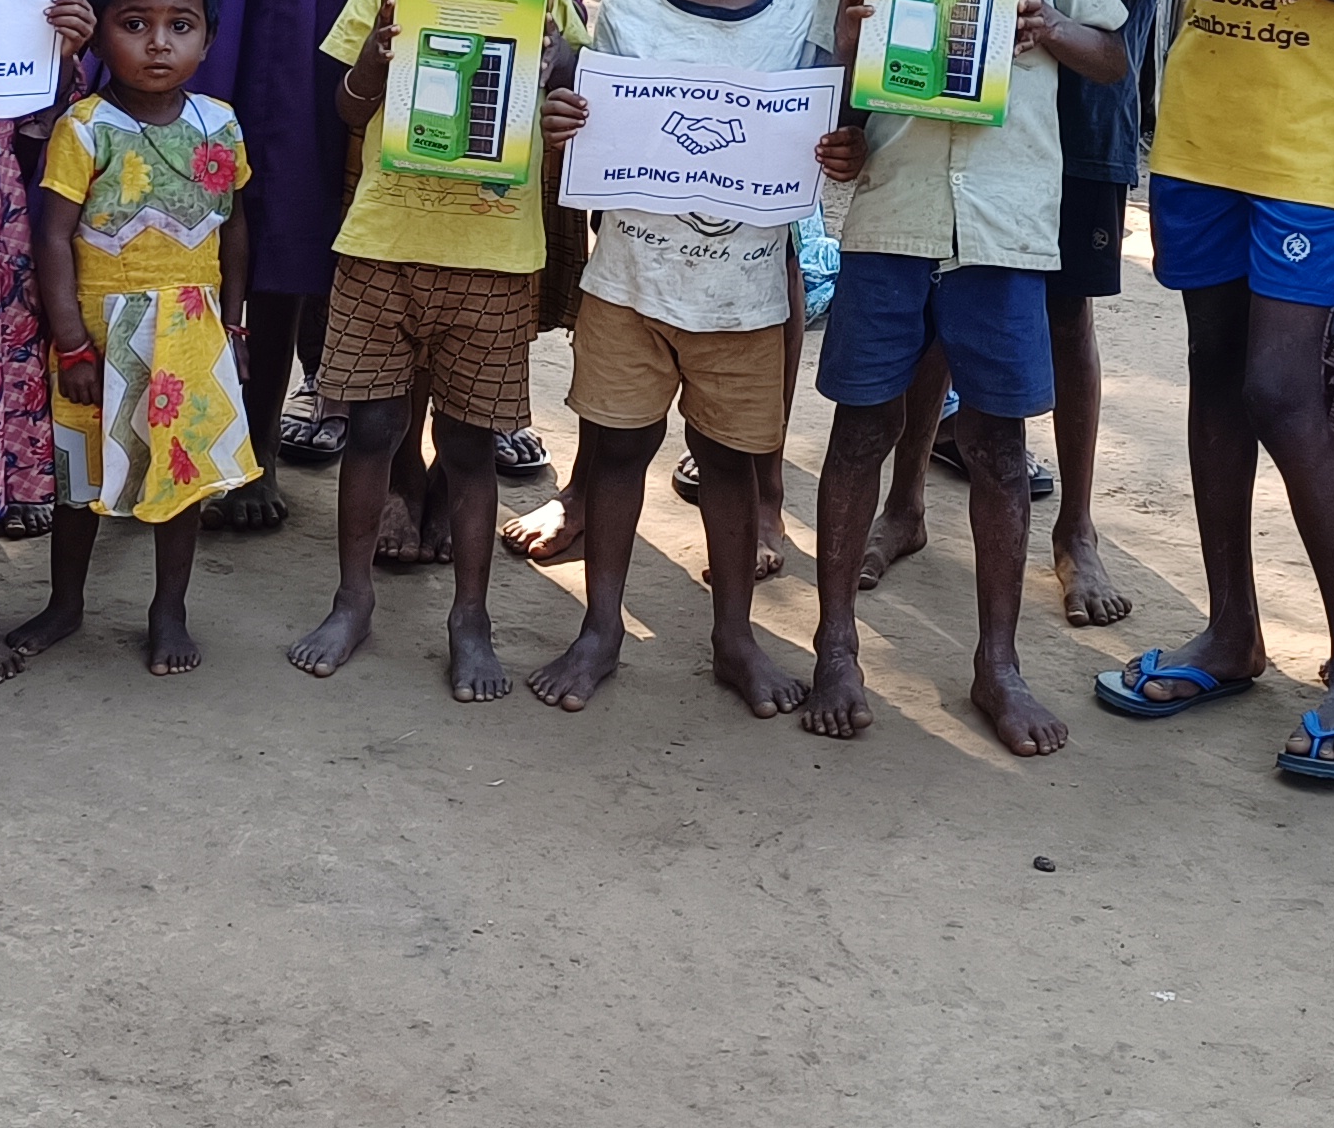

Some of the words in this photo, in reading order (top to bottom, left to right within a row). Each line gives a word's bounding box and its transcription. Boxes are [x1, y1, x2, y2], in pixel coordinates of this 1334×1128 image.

[612, 84, 720, 101] THANKYOU
[724, 92, 751, 107] SO
[756, 97, 810, 113] MUCH
[603, 166, 680, 183] HELPING
[685, 170, 745, 191] HANDS
[751, 181, 800, 196] TEAM
[617, 219, 670, 245] never
[679, 243, 731, 262] catch
